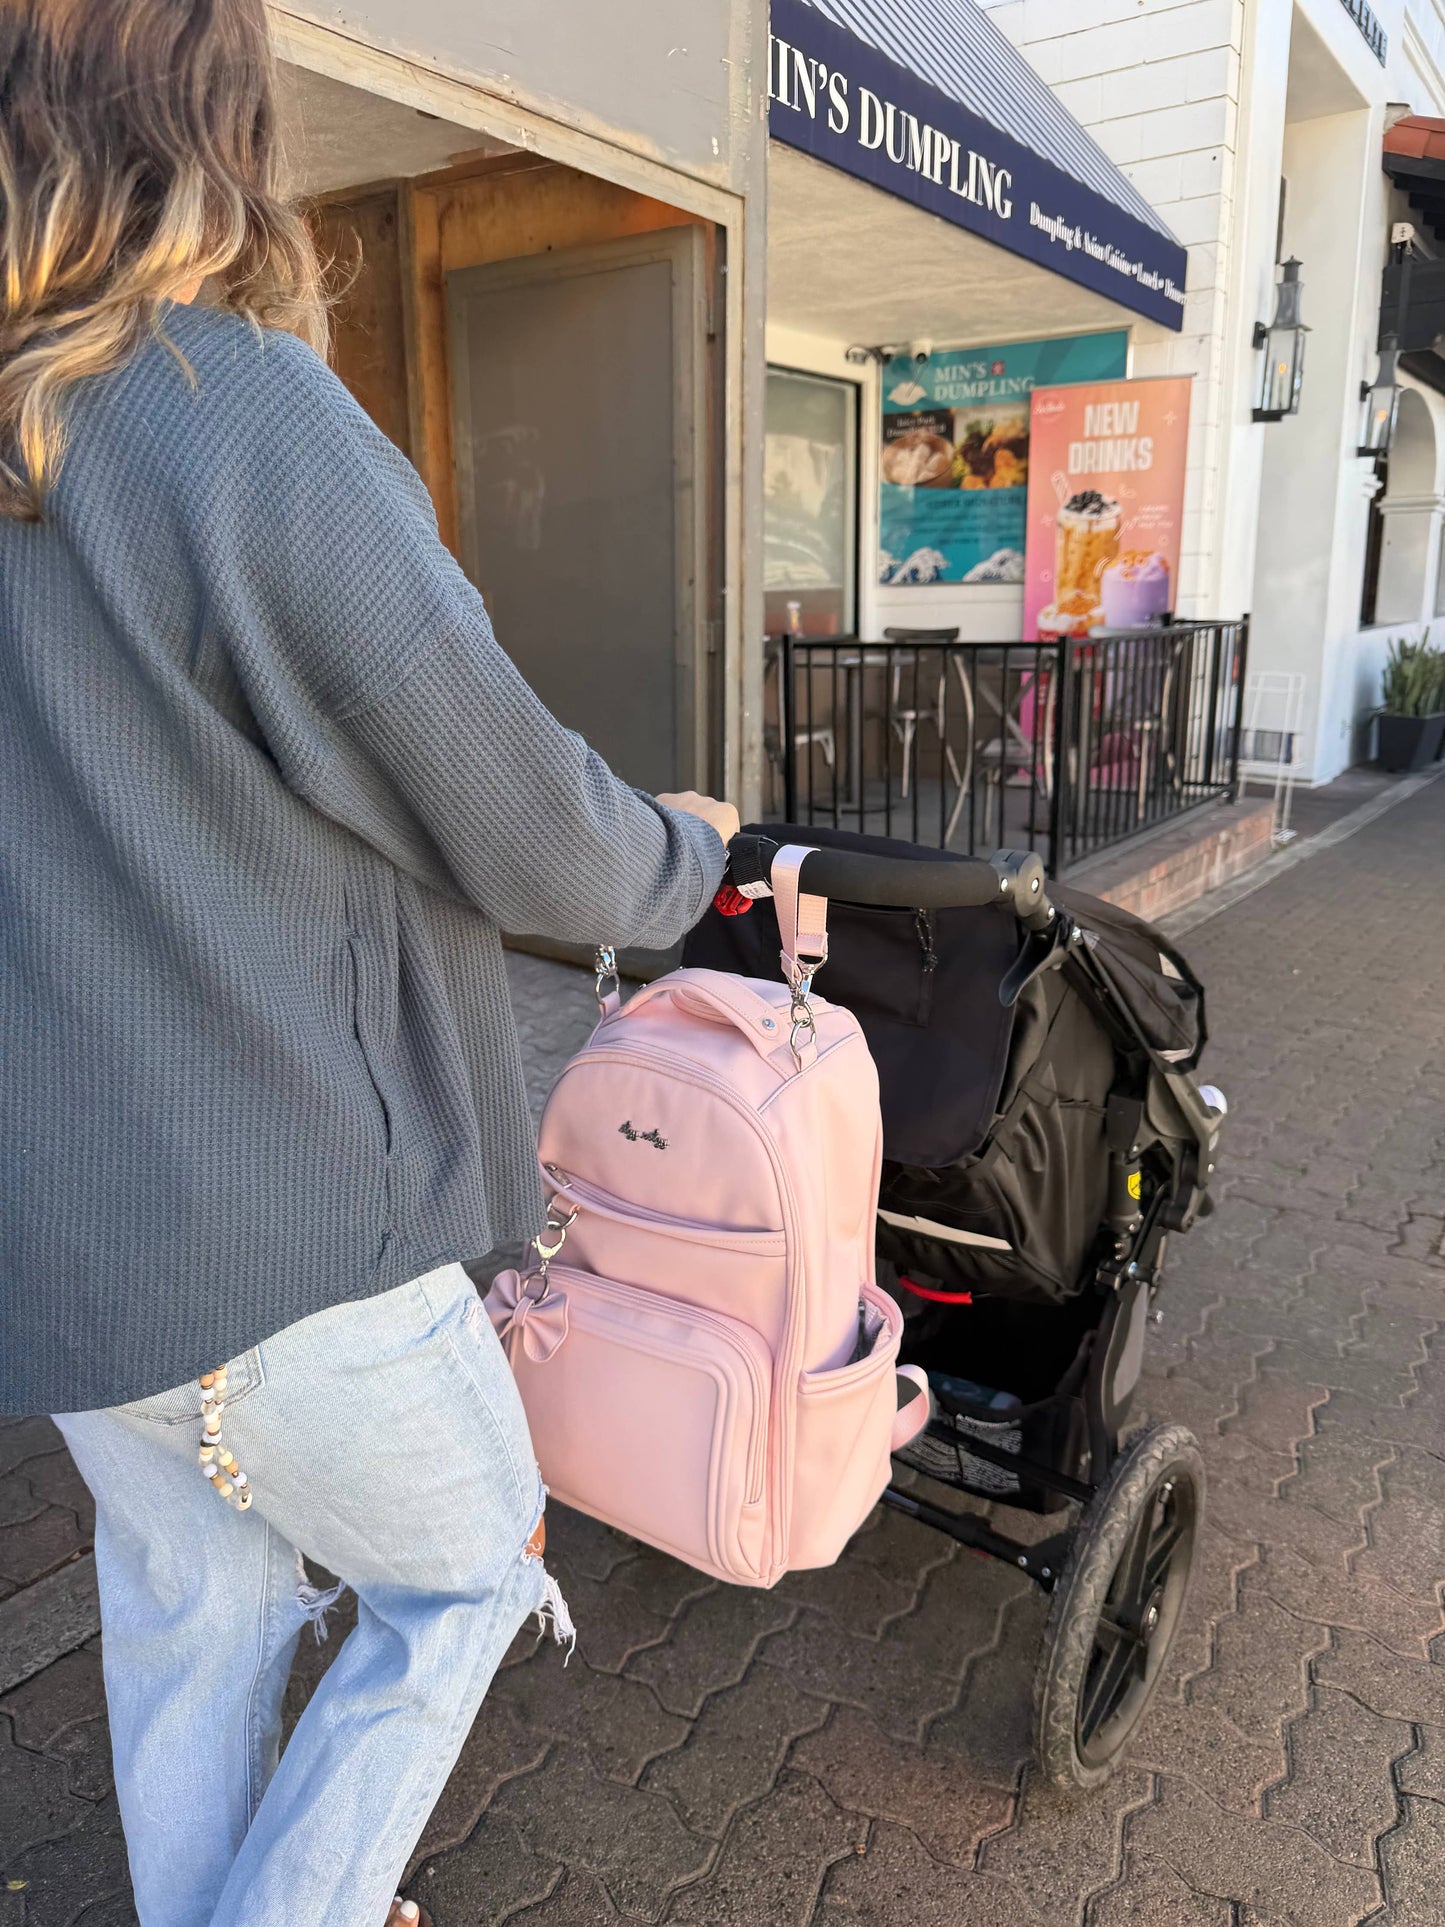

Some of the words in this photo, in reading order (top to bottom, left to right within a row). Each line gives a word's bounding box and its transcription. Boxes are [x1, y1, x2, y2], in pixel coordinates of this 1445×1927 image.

[858, 87, 1012, 219] DUMPLING
[1029, 201, 1075, 251] Dumpling
[1073, 226, 1082, 249] &
[933, 376, 1035, 401] DUMPLING
[934, 361, 987, 383] MIN'S
[1083, 400, 1140, 438] NEW
[1068, 437, 1154, 475] DRINKS
